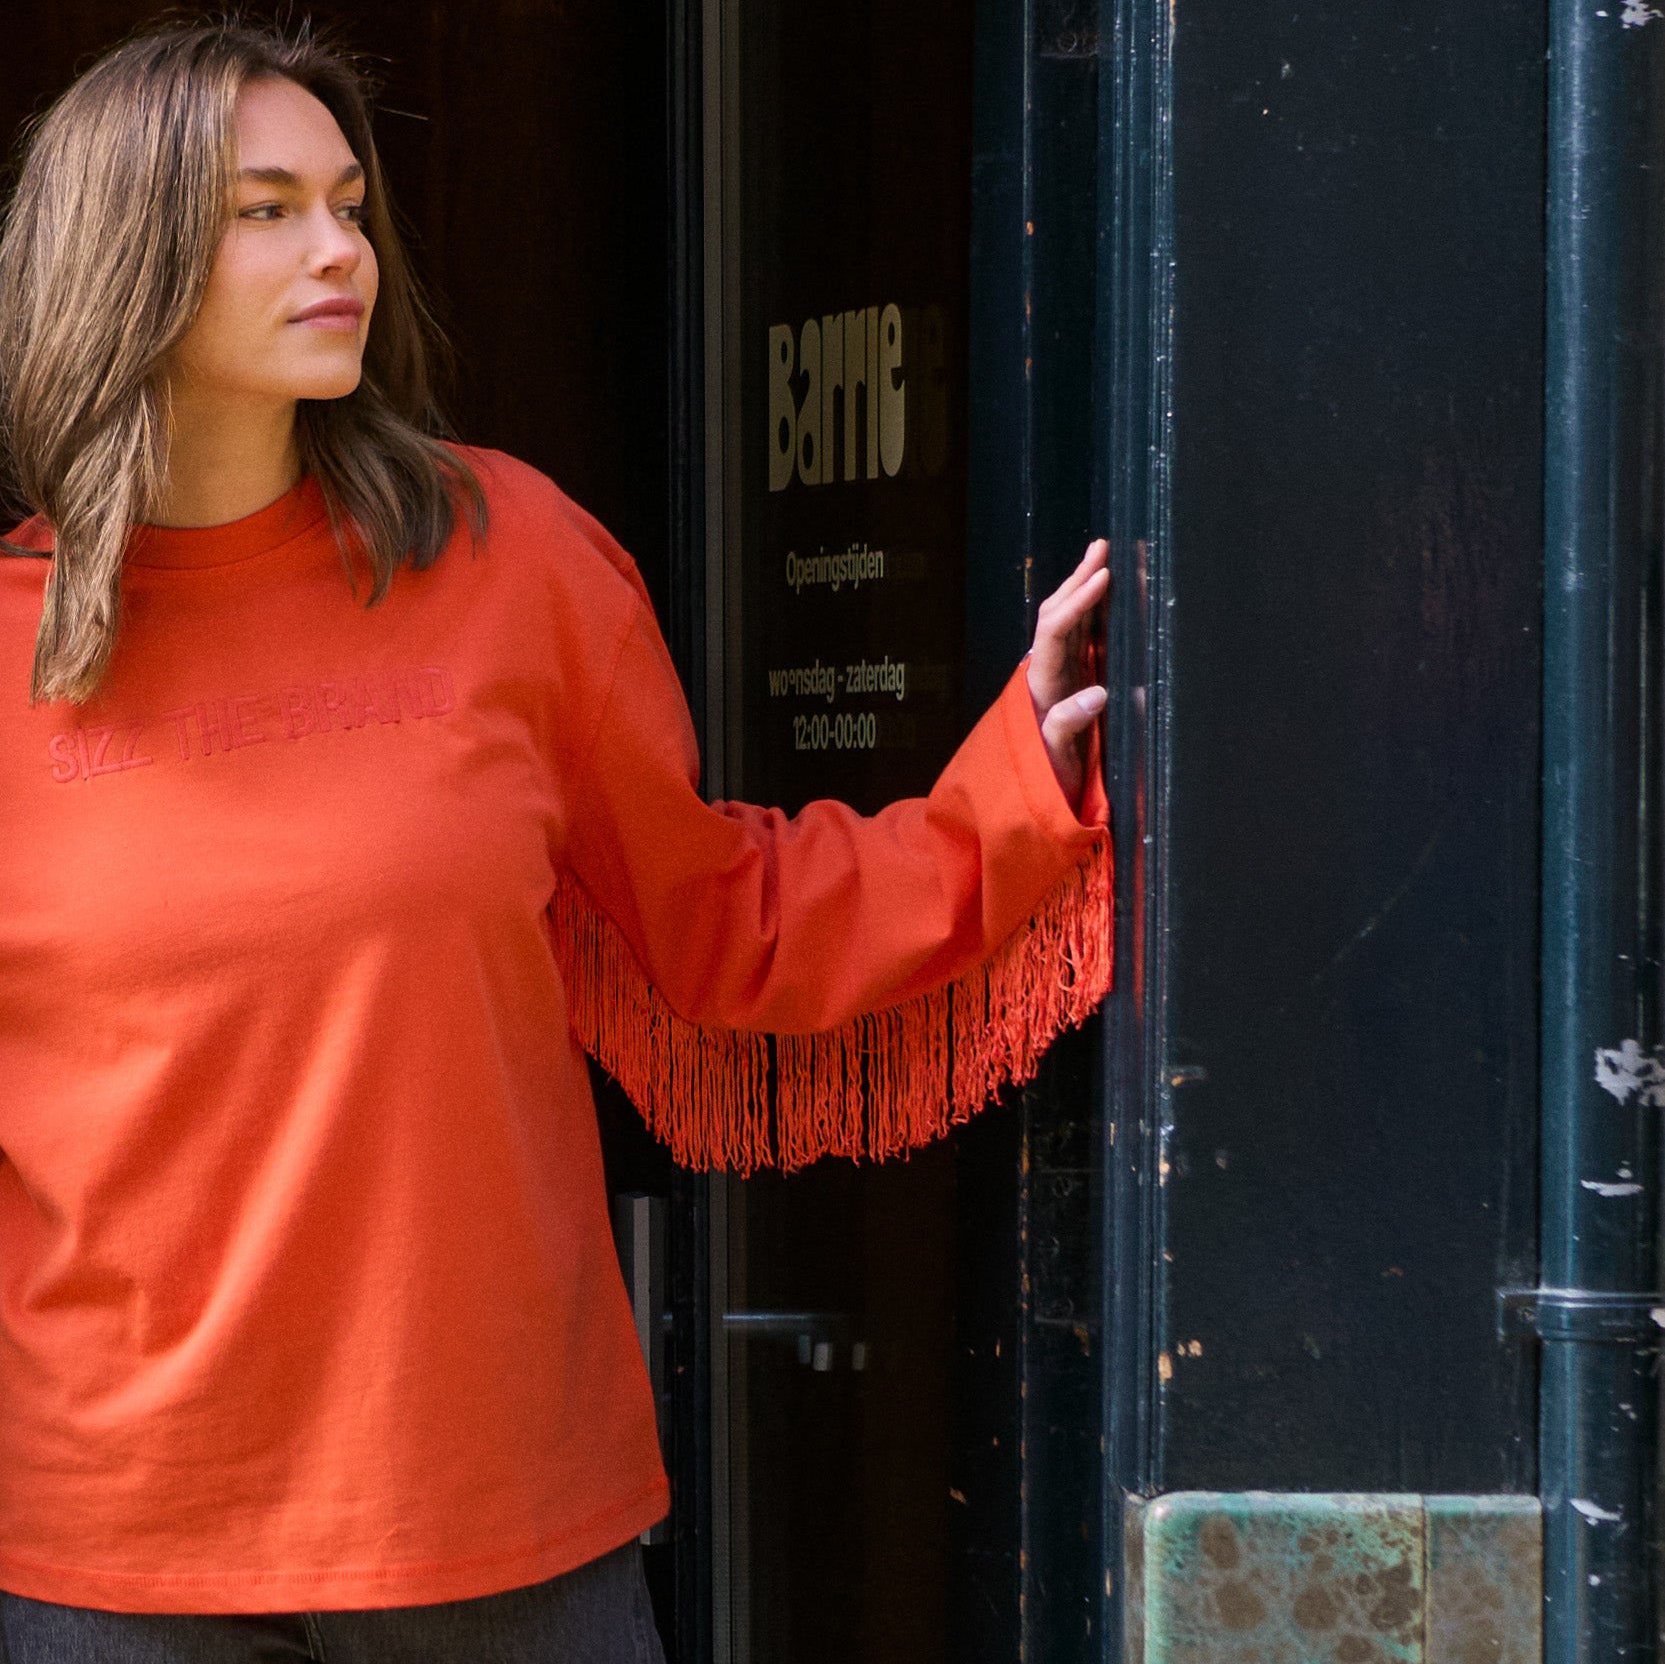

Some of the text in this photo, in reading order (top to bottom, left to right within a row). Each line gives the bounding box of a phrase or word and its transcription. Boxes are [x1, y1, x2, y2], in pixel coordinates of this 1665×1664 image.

[769, 303, 905, 492] Barrie
[786, 543, 884, 595] Openingstijden
[846, 655, 905, 701] zaterdag
[162, 694, 266, 760] THE
[279, 666, 456, 740] BRAND
[793, 713, 876, 750] 12:00-00:00
